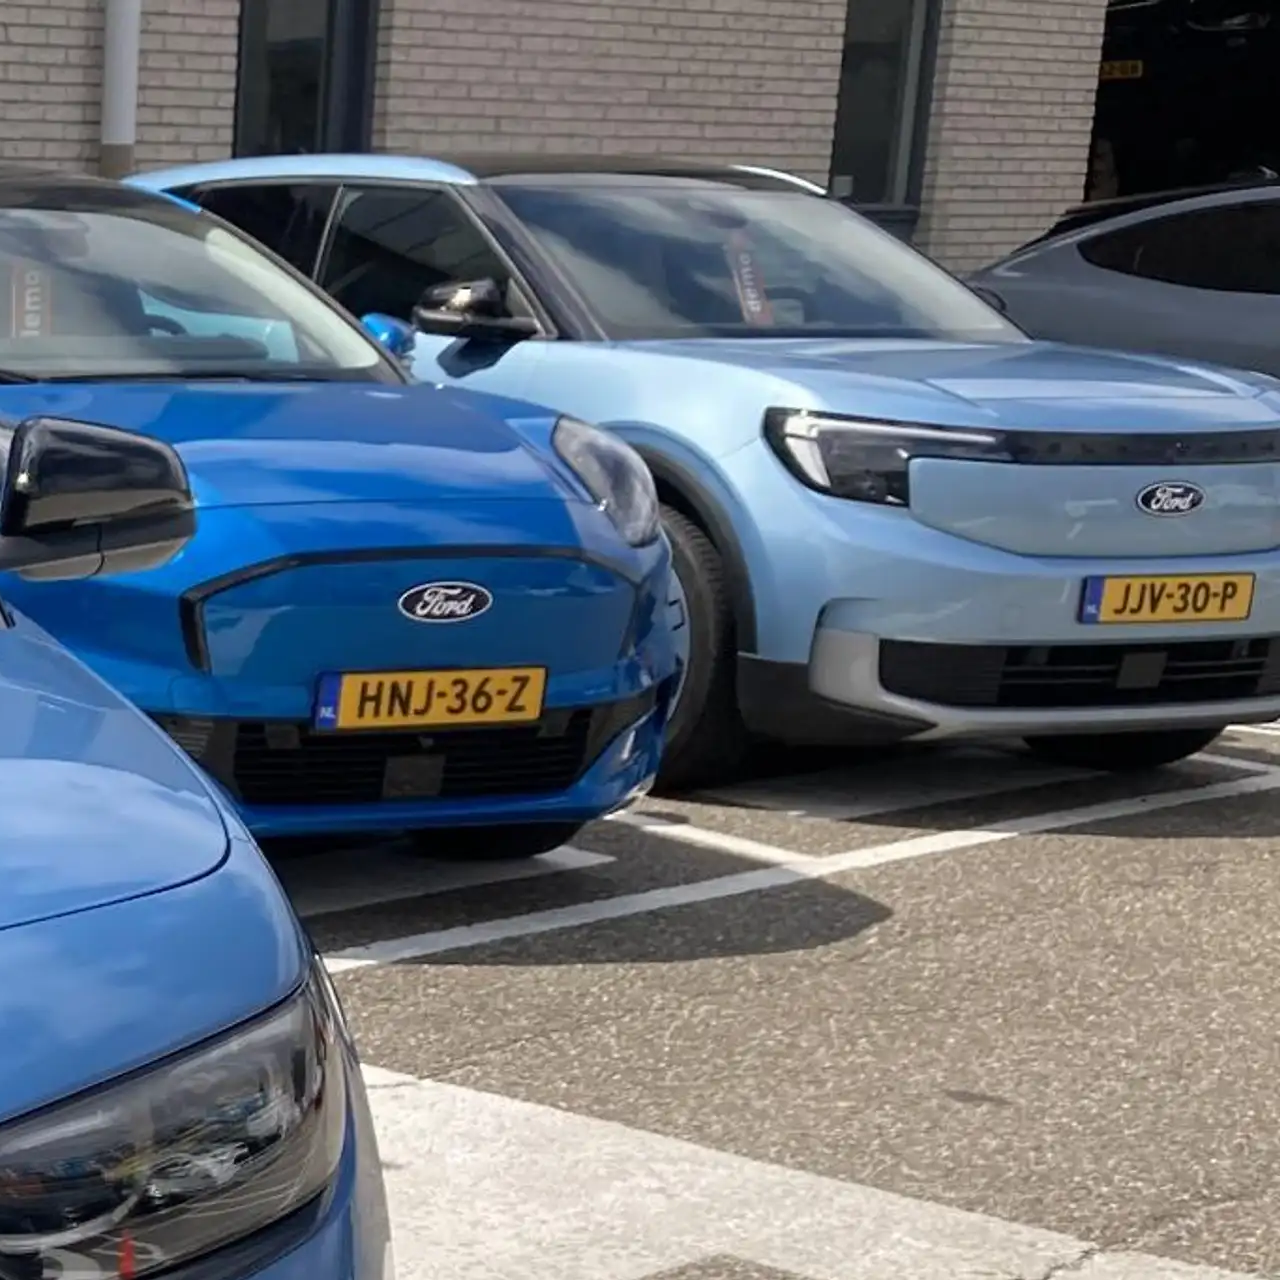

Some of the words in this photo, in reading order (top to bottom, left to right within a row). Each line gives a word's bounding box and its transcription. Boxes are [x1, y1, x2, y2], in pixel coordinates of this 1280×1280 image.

[1151, 486, 1194, 511] Ford
[415, 586, 476, 617] Ford
[1113, 581, 1238, 615] JJV-30-P
[357, 675, 531, 719] HNJ-36-Z
